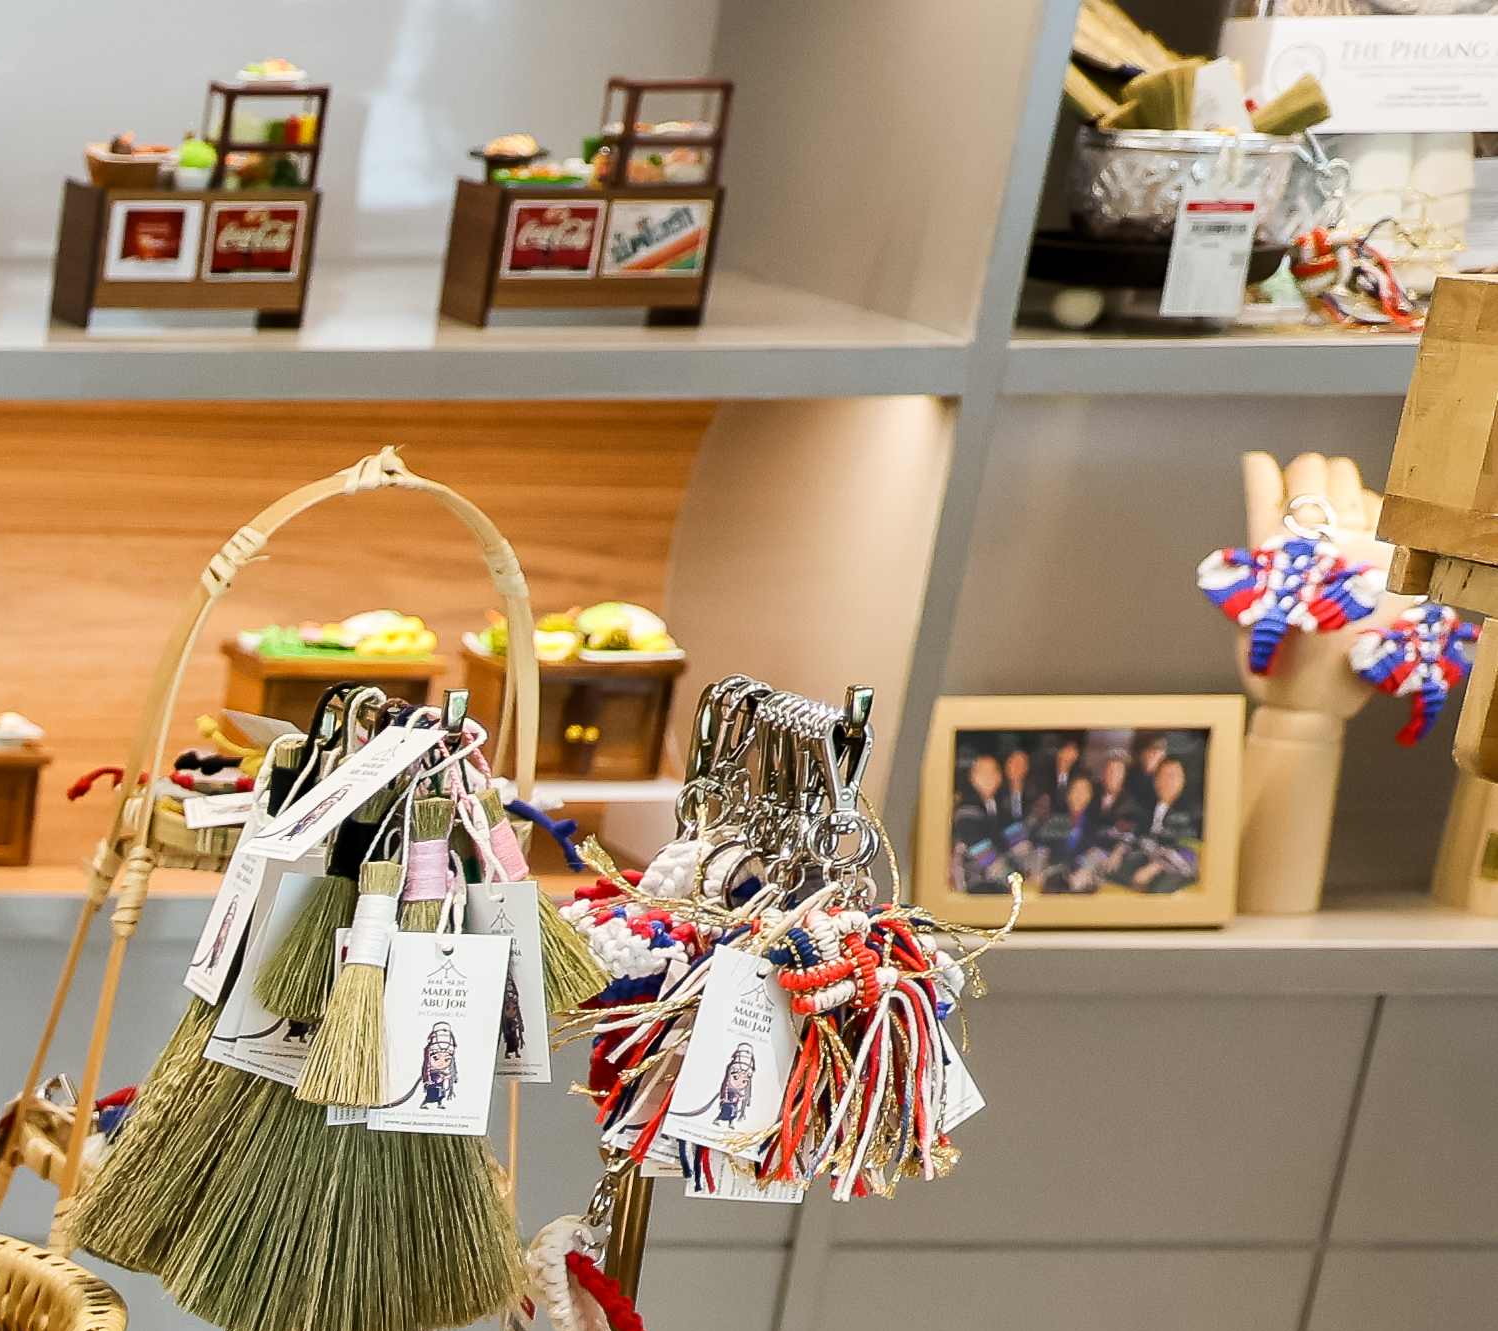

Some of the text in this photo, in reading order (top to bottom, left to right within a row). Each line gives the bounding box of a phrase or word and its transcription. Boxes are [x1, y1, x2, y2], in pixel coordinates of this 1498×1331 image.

[1341, 41, 1379, 59] THE
[421, 988, 469, 997] MADE BY
[420, 999, 466, 1009] ABU JOR
[733, 1004, 774, 1024] MADE BY
[730, 1016, 772, 1034] ABU JAN
